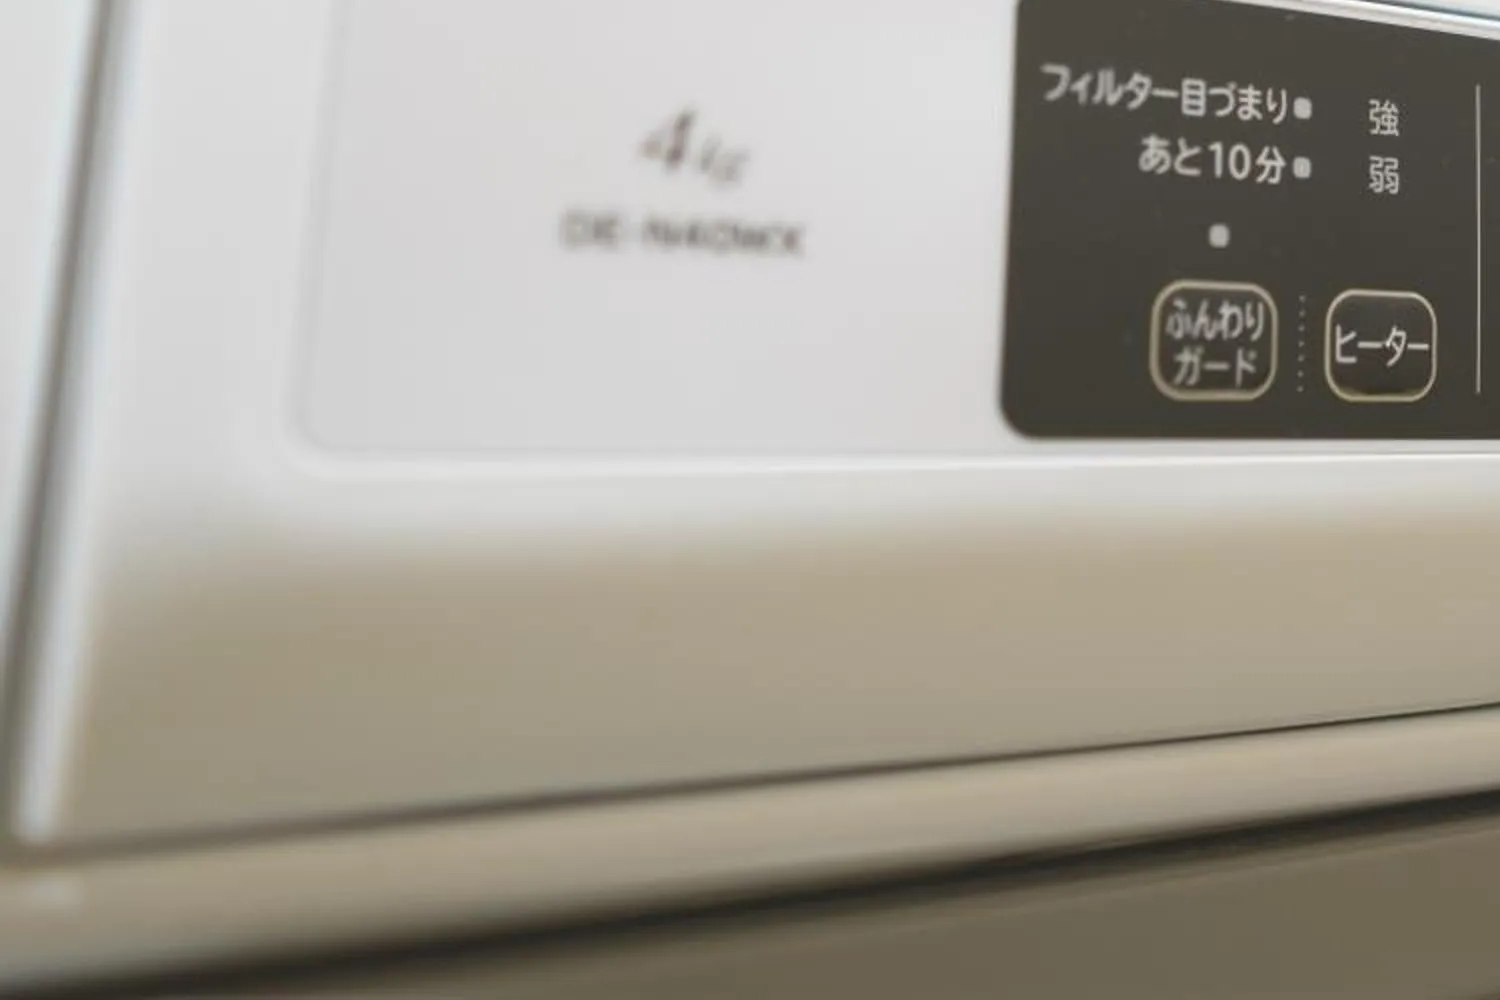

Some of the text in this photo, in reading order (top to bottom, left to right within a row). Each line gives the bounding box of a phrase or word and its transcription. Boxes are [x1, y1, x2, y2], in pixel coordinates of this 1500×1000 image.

[1040, 62, 1288, 125] フィルター目づまり
[1368, 99, 1400, 137] 強
[1138, 133, 1287, 184] あと10分
[1369, 155, 1400, 195] 弱
[1166, 297, 1265, 341] ふんわり
[1173, 346, 1258, 388] ガード
[1335, 323, 1430, 368] ヒーター
